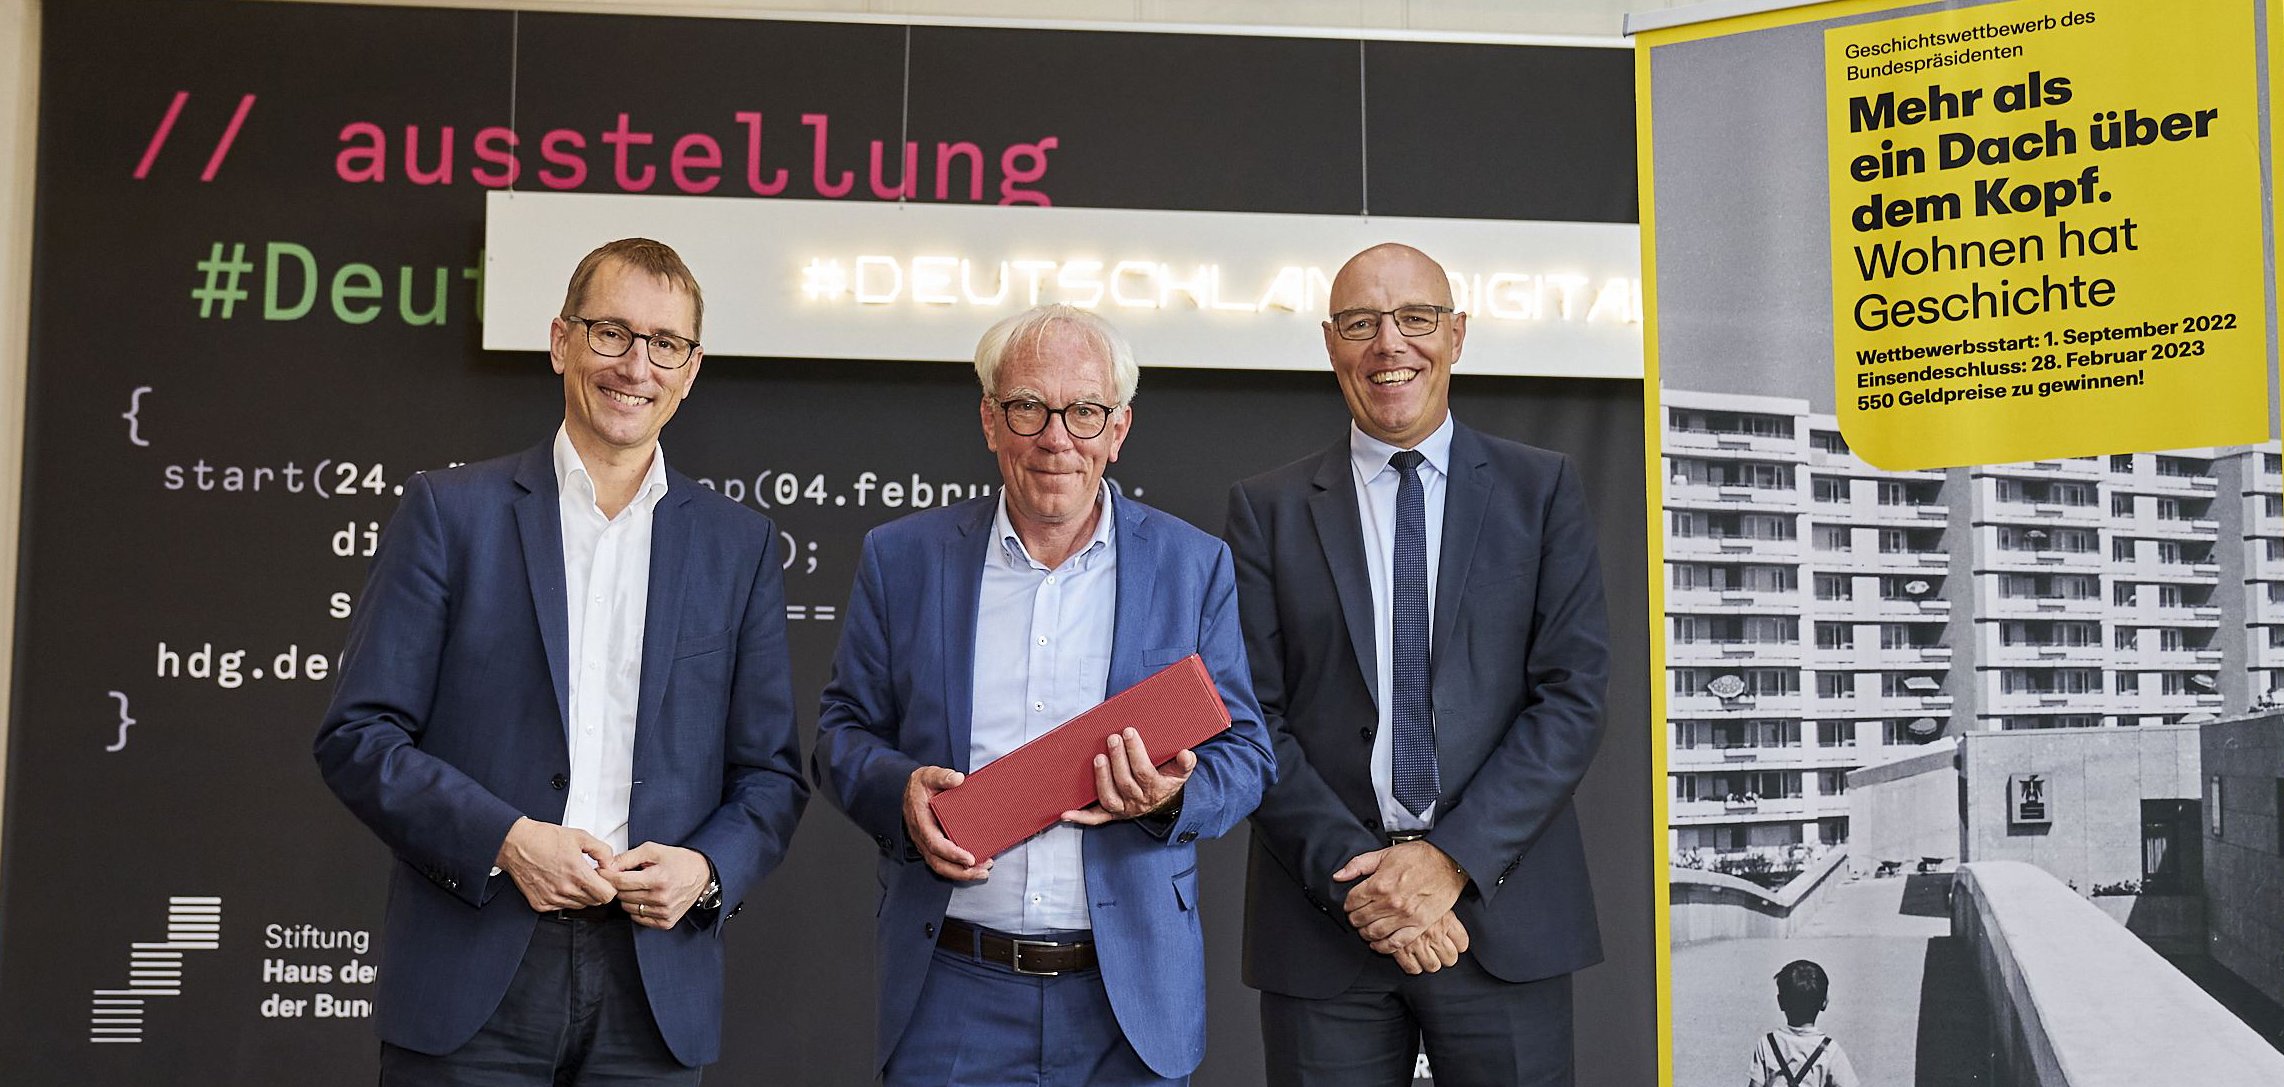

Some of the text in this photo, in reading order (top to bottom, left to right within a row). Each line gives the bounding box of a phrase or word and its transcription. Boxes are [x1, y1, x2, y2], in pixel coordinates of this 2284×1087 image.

[1845, 11, 2096, 59] Geschichtswettbewerb des
[1847, 45, 2023, 81] Bundespräsidenten
[1849, 70, 2073, 134] Mehr als
[134, 91, 1058, 208] // ausstellung
[1850, 107, 2218, 183] ein Dach über
[1851, 165, 2112, 233] dem Kopf.
[1853, 217, 2139, 282] Wohnen hat
[1854, 274, 2116, 332] Geschichte
[1855, 313, 2237, 366] Wettbewerbsstart: 1. September 2022
[1857, 339, 2205, 389] Einsendeschluss: 28. Februar 2023
[1857, 369, 2145, 411] 550 Geldpreise zu gewinnen!
[164, 459, 467, 499] start(24.
[265, 923, 371, 955] Stiftung
[263, 958, 334, 984] Haus
[261, 993, 374, 1018] der Bun
